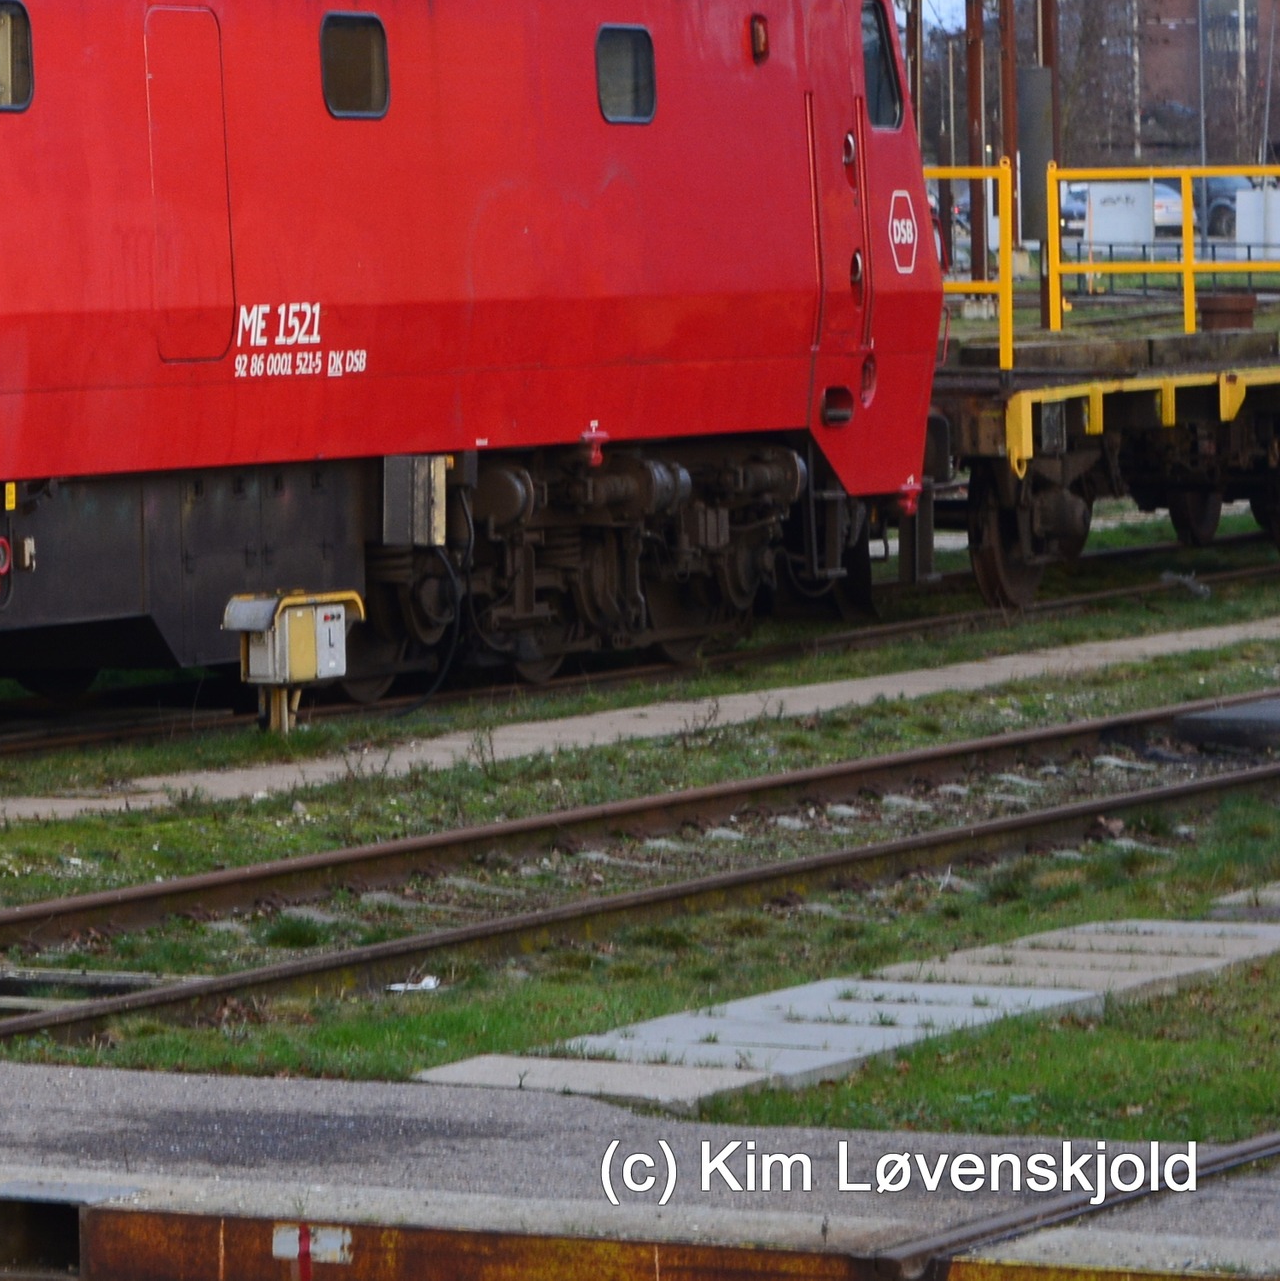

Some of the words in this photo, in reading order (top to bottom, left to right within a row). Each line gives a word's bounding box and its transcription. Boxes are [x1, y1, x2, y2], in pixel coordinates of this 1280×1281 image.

[893, 218, 914, 244] DSB
[237, 304, 270, 347] ME
[275, 302, 321, 345] 1521
[234, 353, 248, 378] 92
[250, 353, 265, 377] 86
[266, 352, 292, 376] 0001
[295, 351, 322, 375] 521-5
[327, 350, 344, 377] DK
[345, 349, 366, 373] DSB
